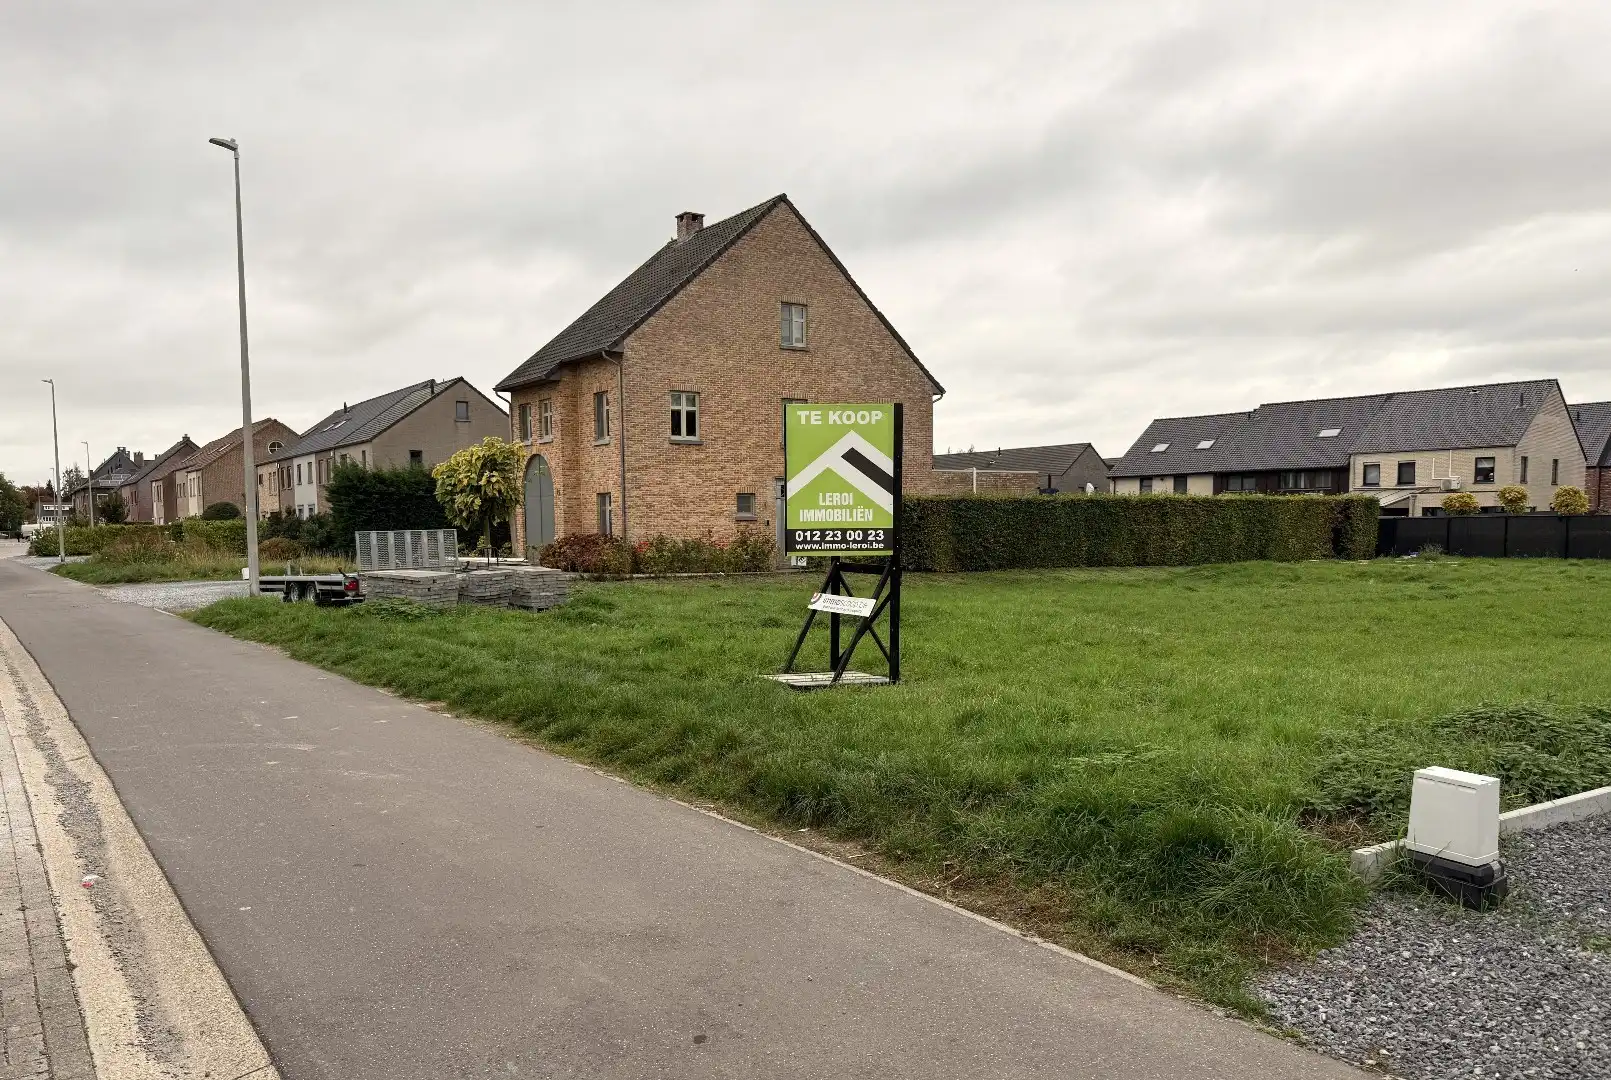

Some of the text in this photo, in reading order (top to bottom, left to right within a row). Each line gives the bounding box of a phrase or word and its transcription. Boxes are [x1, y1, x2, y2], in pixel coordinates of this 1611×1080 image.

[796, 410, 883, 425] TE KOOP
[818, 492, 854, 506] LEROI
[799, 505, 874, 522] IMMOBILIËN
[795, 529, 885, 542] 012 23 00 23
[795, 541, 885, 550] www.immo-leroi.be
